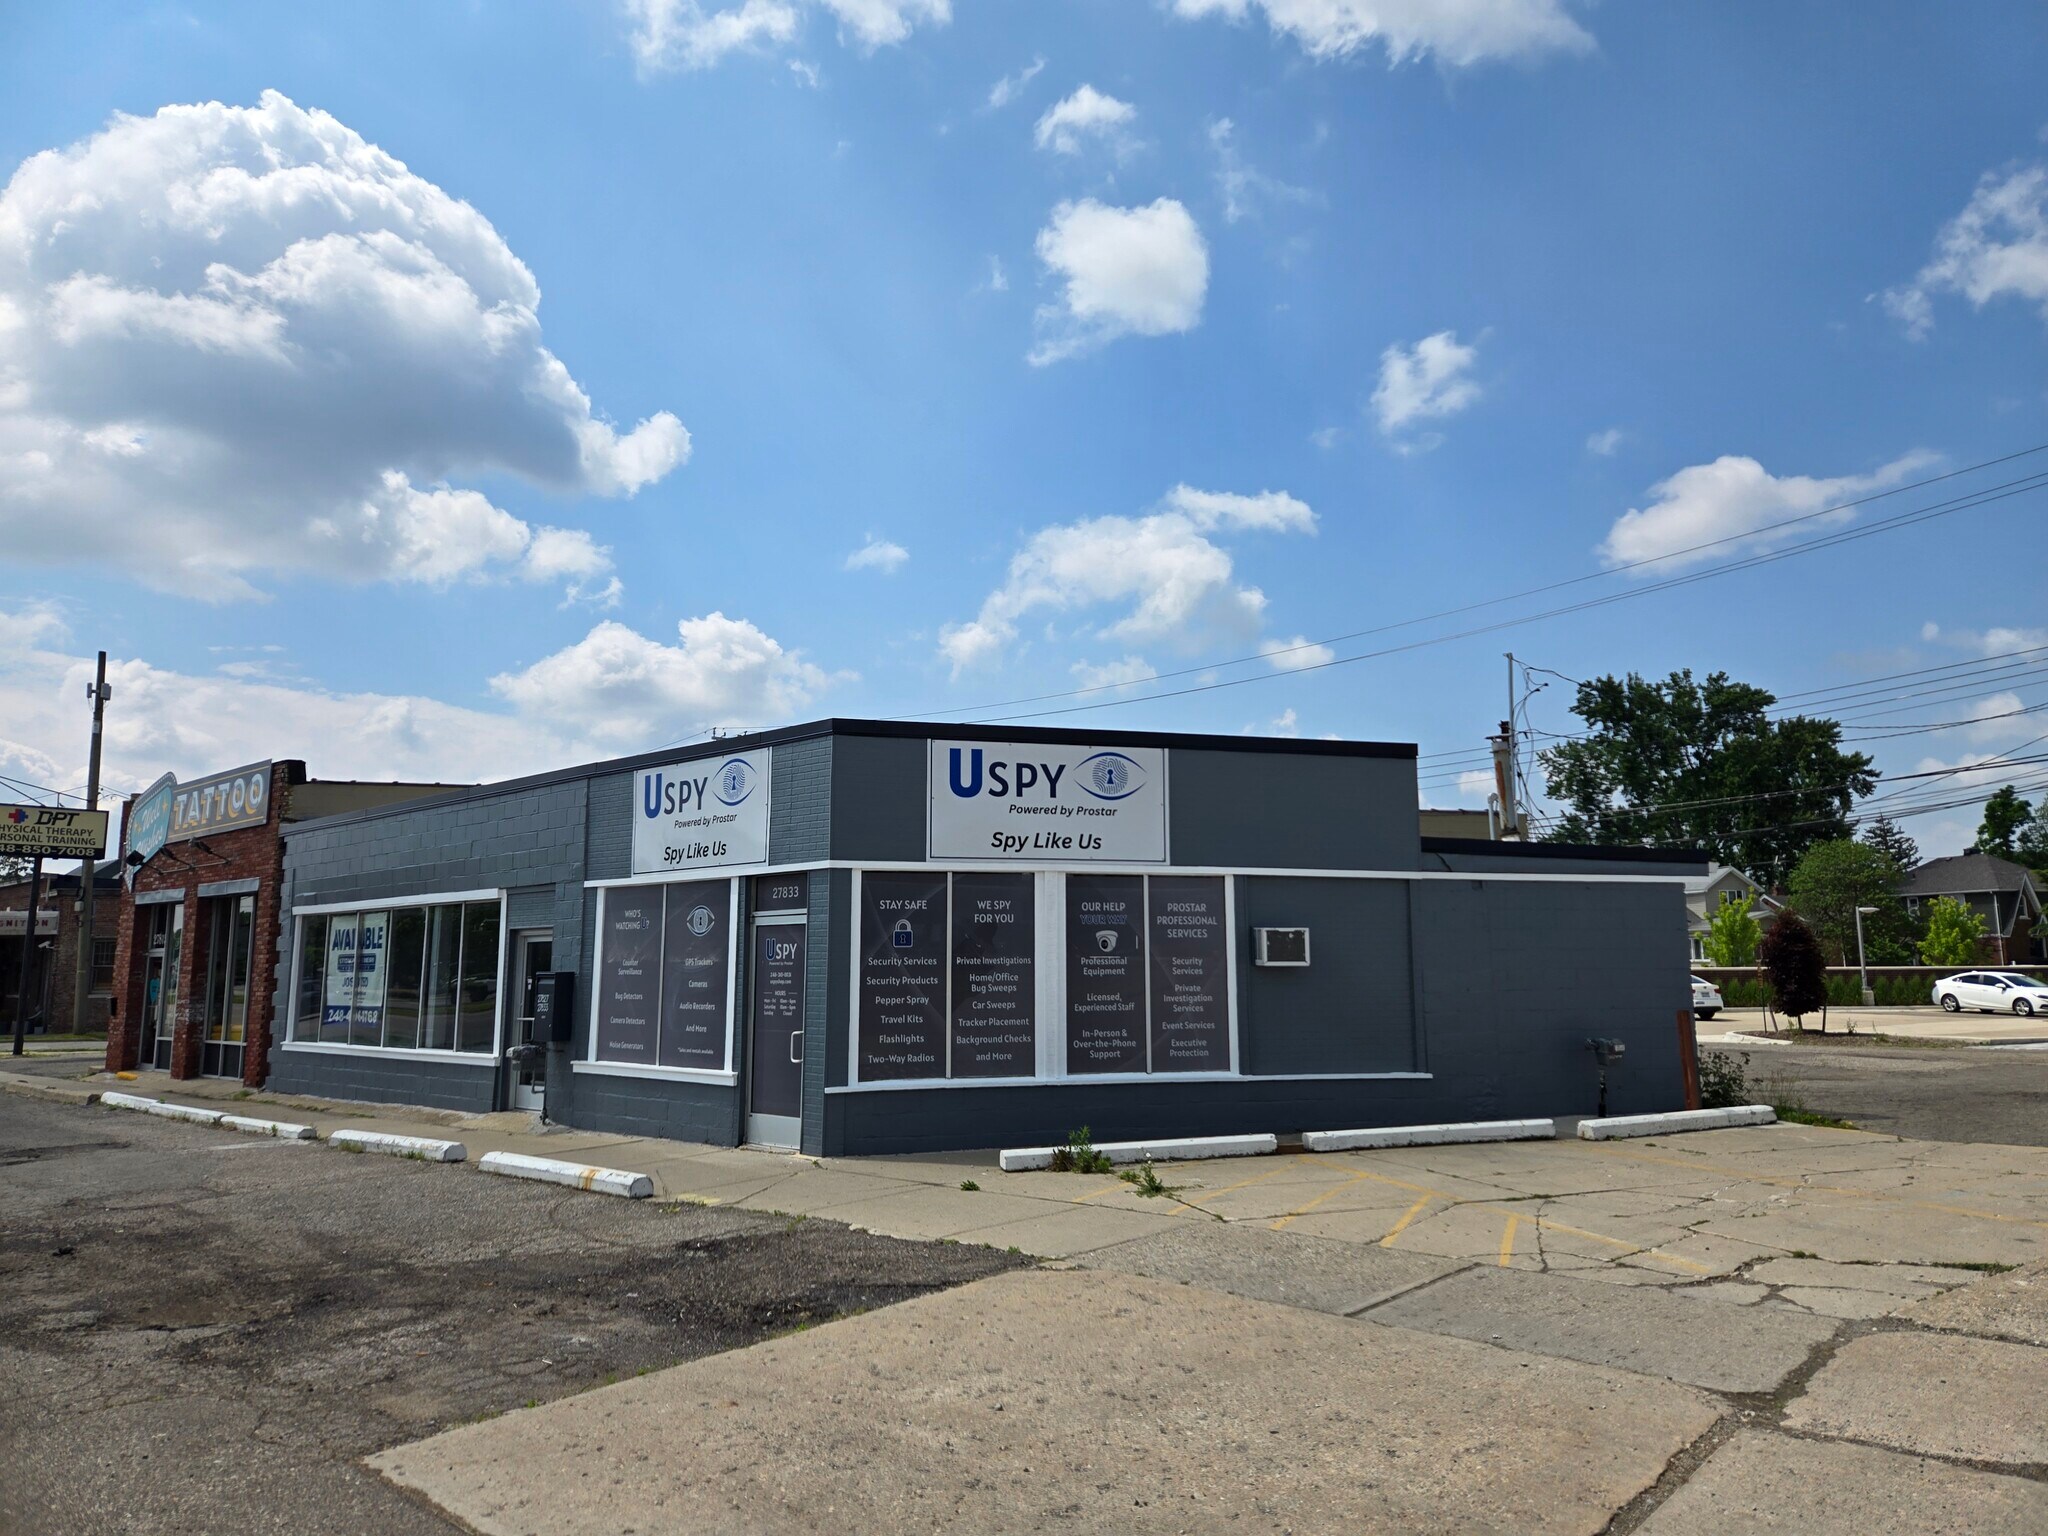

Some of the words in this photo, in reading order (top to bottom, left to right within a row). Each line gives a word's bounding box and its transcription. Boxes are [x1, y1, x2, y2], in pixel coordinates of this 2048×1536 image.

[950, 748, 1066, 798] USPY
[644, 772, 708, 818] USPY
[173, 773, 263, 830] TATTOO
[1008, 804, 1058, 815] Powered
[1060, 804, 1074, 818] by
[1076, 806, 1118, 816] Prostar
[34, 810, 80, 826] DPT
[674, 816, 702, 829] Powered
[702, 816, 711, 828] by
[712, 813, 738, 824] Prostar
[45, 826, 94, 836] THERAPY
[46, 836, 96, 846] TRAINING
[990, 832, 1030, 852] Spy
[1033, 832, 1072, 849] Like
[1078, 834, 1102, 850] Us
[664, 846, 685, 864] Spy
[686, 842, 709, 860] Like
[712, 840, 727, 856] Us
[772, 886, 799, 898] 27833
[880, 900, 902, 910] STAY
[904, 900, 928, 910] SAFE
[977, 900, 992, 910] WE
[994, 900, 1011, 910] SPY
[1081, 902, 1100, 911] OUR
[1103, 902, 1125, 911] HELP
[1167, 903, 1207, 912] PROSTAR
[624, 909, 642, 918] WHO'S
[974, 914, 992, 923] FOR
[994, 914, 1014, 923] YOU
[1080, 914, 1105, 924] YOUR
[1107, 914, 1127, 924] WAY
[1157, 916, 1218, 925] PROFESSIONAL
[616, 921, 640, 930] WATCHING
[332, 926, 384, 951] AVAIBLE
[1167, 929, 1208, 938] SERVICES
[765, 938, 798, 960] USPY
[684, 958, 694, 966] GPS
[695, 958, 714, 966] Trackers
[868, 956, 902, 967] Security
[904, 957, 937, 966] Services
[956, 957, 981, 965] Private
[982, 956, 1032, 966] Investigations
[1081, 957, 1127, 965] Professional
[1172, 957, 1203, 966] Security
[618, 968, 642, 976] Surveillance
[1083, 967, 1125, 977] Equipment
[866, 977, 900, 986] Security
[902, 976, 938, 985] Products
[969, 973, 1019, 983] Home/Office
[688, 980, 708, 988] Cameras
[971, 984, 986, 994] Bug
[988, 984, 1017, 994] Sweeps
[614, 992, 623, 1001] Bug
[623, 992, 643, 1000] Detectors
[875, 996, 905, 1006] Pepper
[906, 996, 929, 1006] Spray
[1087, 993, 1122, 1002] Licensed,
[1163, 995, 1213, 1004] Investigation
[680, 1002, 692, 1010] Audio
[693, 1002, 716, 1010] Recorders
[972, 1001, 985, 1009] Car
[987, 1001, 1016, 1010] Sweeps
[1074, 1003, 1117, 1013] Experienced
[1118, 1002, 1134, 1011] Staff
[610, 1016, 625, 1024] Camera
[626, 1016, 646, 1025] Detectors
[880, 1015, 905, 1024] Travel
[907, 1015, 923, 1023] Kits
[958, 1018, 987, 1027] Tracker
[989, 1018, 1029, 1026] Placement
[686, 1024, 695, 1032] And
[696, 1024, 707, 1033] More
[1082, 1029, 1120, 1037] In-Person
[1122, 1029, 1127, 1037] &
[879, 1035, 925, 1044] Flashlights
[956, 1035, 1002, 1045] Background
[1004, 1034, 1032, 1043] Checks
[1073, 1040, 1136, 1048] Over-the-Phone
[609, 1041, 621, 1049] Noise
[621, 1042, 644, 1050] Generators
[868, 1054, 905, 1064] Two-Way
[908, 1054, 935, 1062] Radios
[976, 1053, 990, 1061] and
[992, 1052, 1012, 1060] More
[1090, 1050, 1120, 1060] Support
